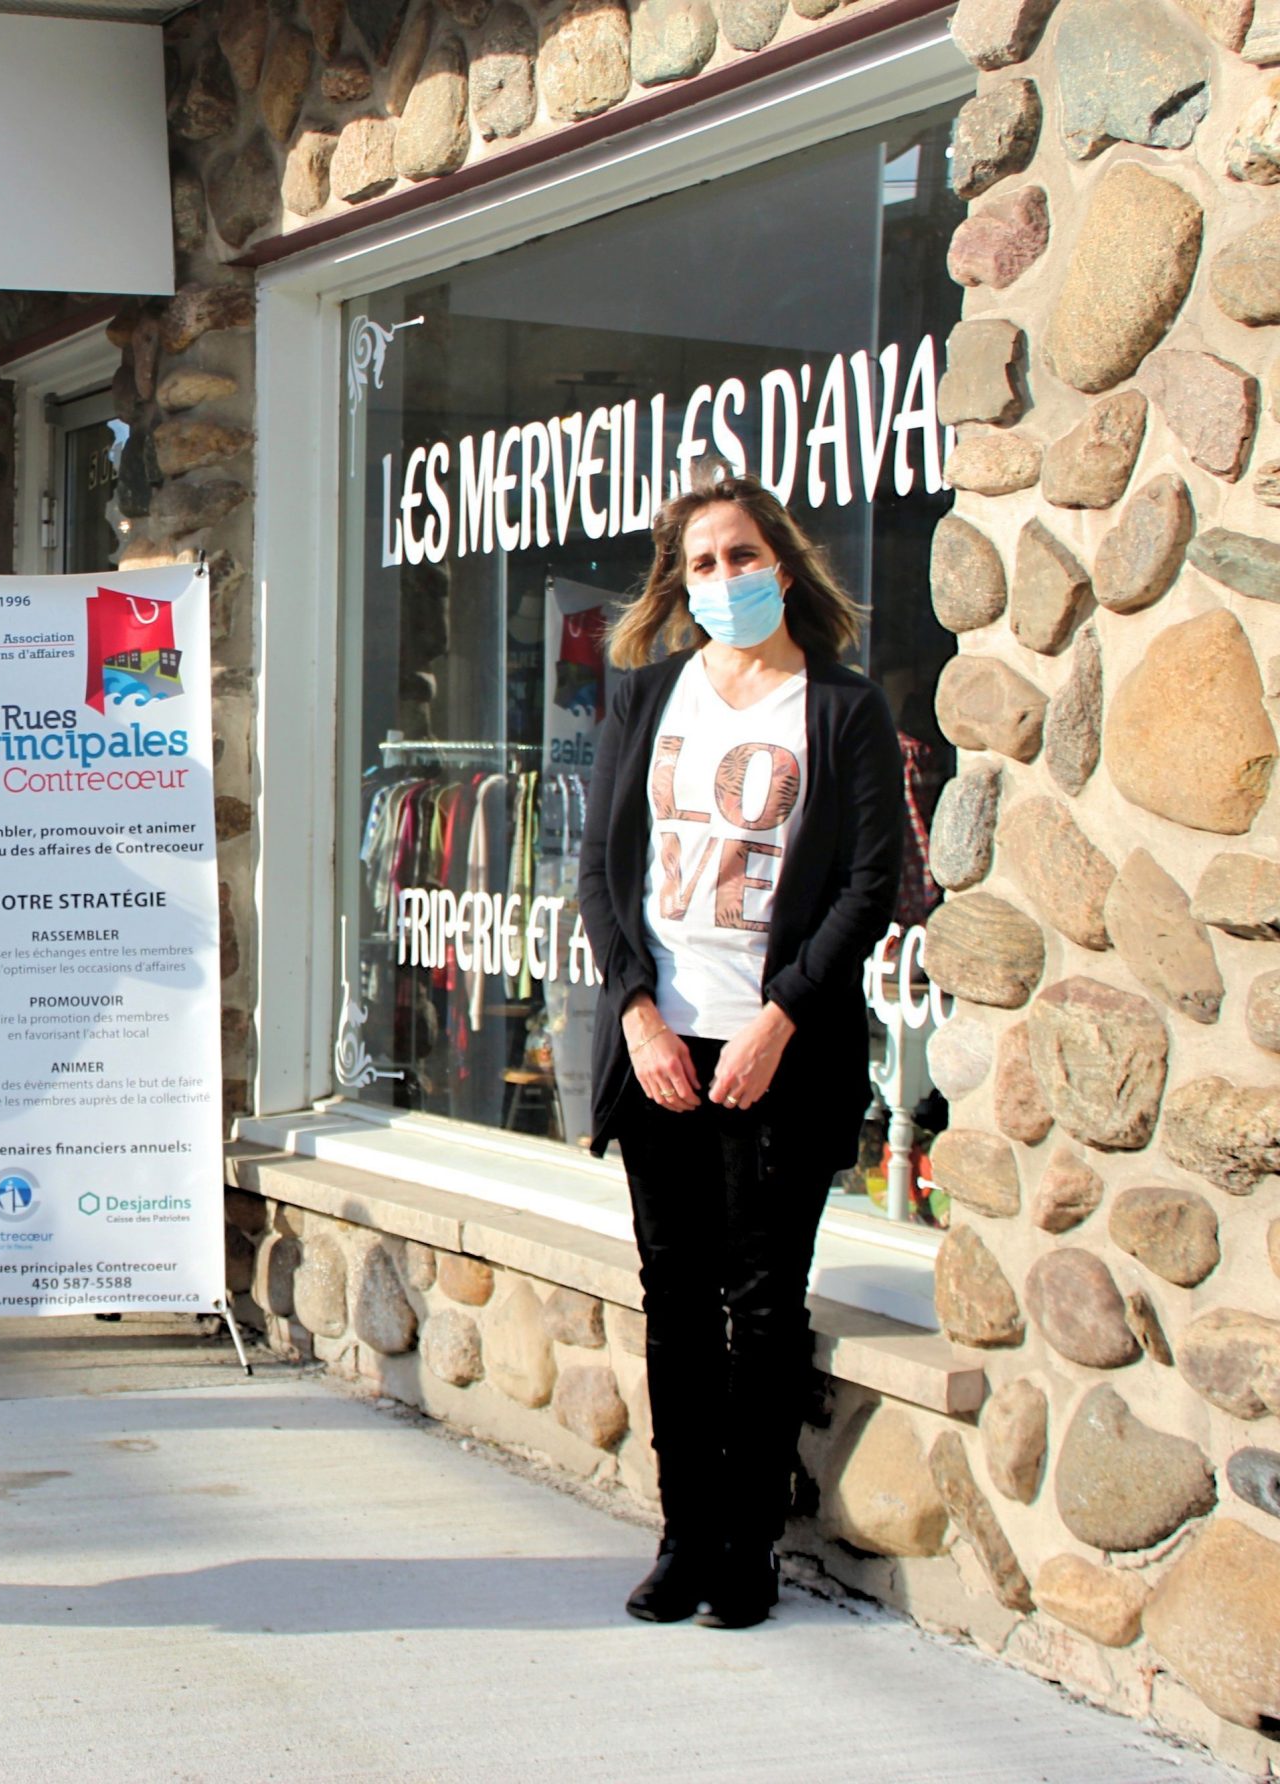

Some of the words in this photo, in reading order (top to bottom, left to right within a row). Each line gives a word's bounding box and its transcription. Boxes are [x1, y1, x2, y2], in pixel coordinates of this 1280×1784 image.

[381, 441, 451, 568] LES
[458, 377, 746, 558] MERVEILLES
[3, 632, 75, 644] Association
[18, 648, 75, 660] d'affaires
[1, 705, 77, 730] Rues
[3, 767, 189, 793] Contrecœur
[40, 823, 125, 840] promouvoir
[128, 823, 143, 835] et
[146, 821, 197, 834] animer
[10, 844, 35, 857] des
[39, 842, 91, 856] affaires
[94, 842, 113, 855] de
[116, 841, 204, 854] Contrecoeur
[59, 890, 167, 910] STRATÉGIE
[31, 930, 119, 942] RASSEMBLER
[398, 887, 521, 977] FRIPERIE
[526, 895, 564, 982] ET
[14, 948, 30, 959] les
[32, 947, 87, 961] échanges
[89, 948, 119, 958] entre
[121, 946, 137, 957] les
[140, 945, 194, 957] membres
[60, 963, 75, 974] les
[77, 962, 132, 974] occasions
[135, 961, 186, 973] d'affaires
[30, 995, 124, 1007] PROMOUVOIR
[17, 1013, 27, 1025] la
[30, 1013, 91, 1026] promotion
[93, 1012, 113, 1023] des
[115, 1010, 170, 1022] membres
[7, 1031, 22, 1041] en
[24, 1029, 80, 1041] favorisant
[83, 1027, 120, 1040] l'achat
[122, 1027, 149, 1039] local
[50, 1062, 104, 1073] ANIMER
[1, 1079, 22, 1090] des
[96, 1078, 124, 1089] dans
[126, 1078, 136, 1089] le
[139, 1077, 159, 1088] but
[161, 1077, 176, 1087] de
[178, 1075, 204, 1087] faire
[4, 1096, 20, 1107] les
[23, 1095, 77, 1106] membres
[79, 1094, 117, 1107] auprès
[120, 1094, 135, 1105] de
[137, 1093, 147, 1105] la
[56, 1142, 127, 1156] financiers
[130, 1140, 192, 1155] annuels:
[106, 1195, 192, 1214] Desjardins
[21, 1261, 93, 1276] principales
[96, 1260, 178, 1273] Contrecoeur
[32, 1278, 59, 1290] 450
[63, 1277, 132, 1289] 587-5588
